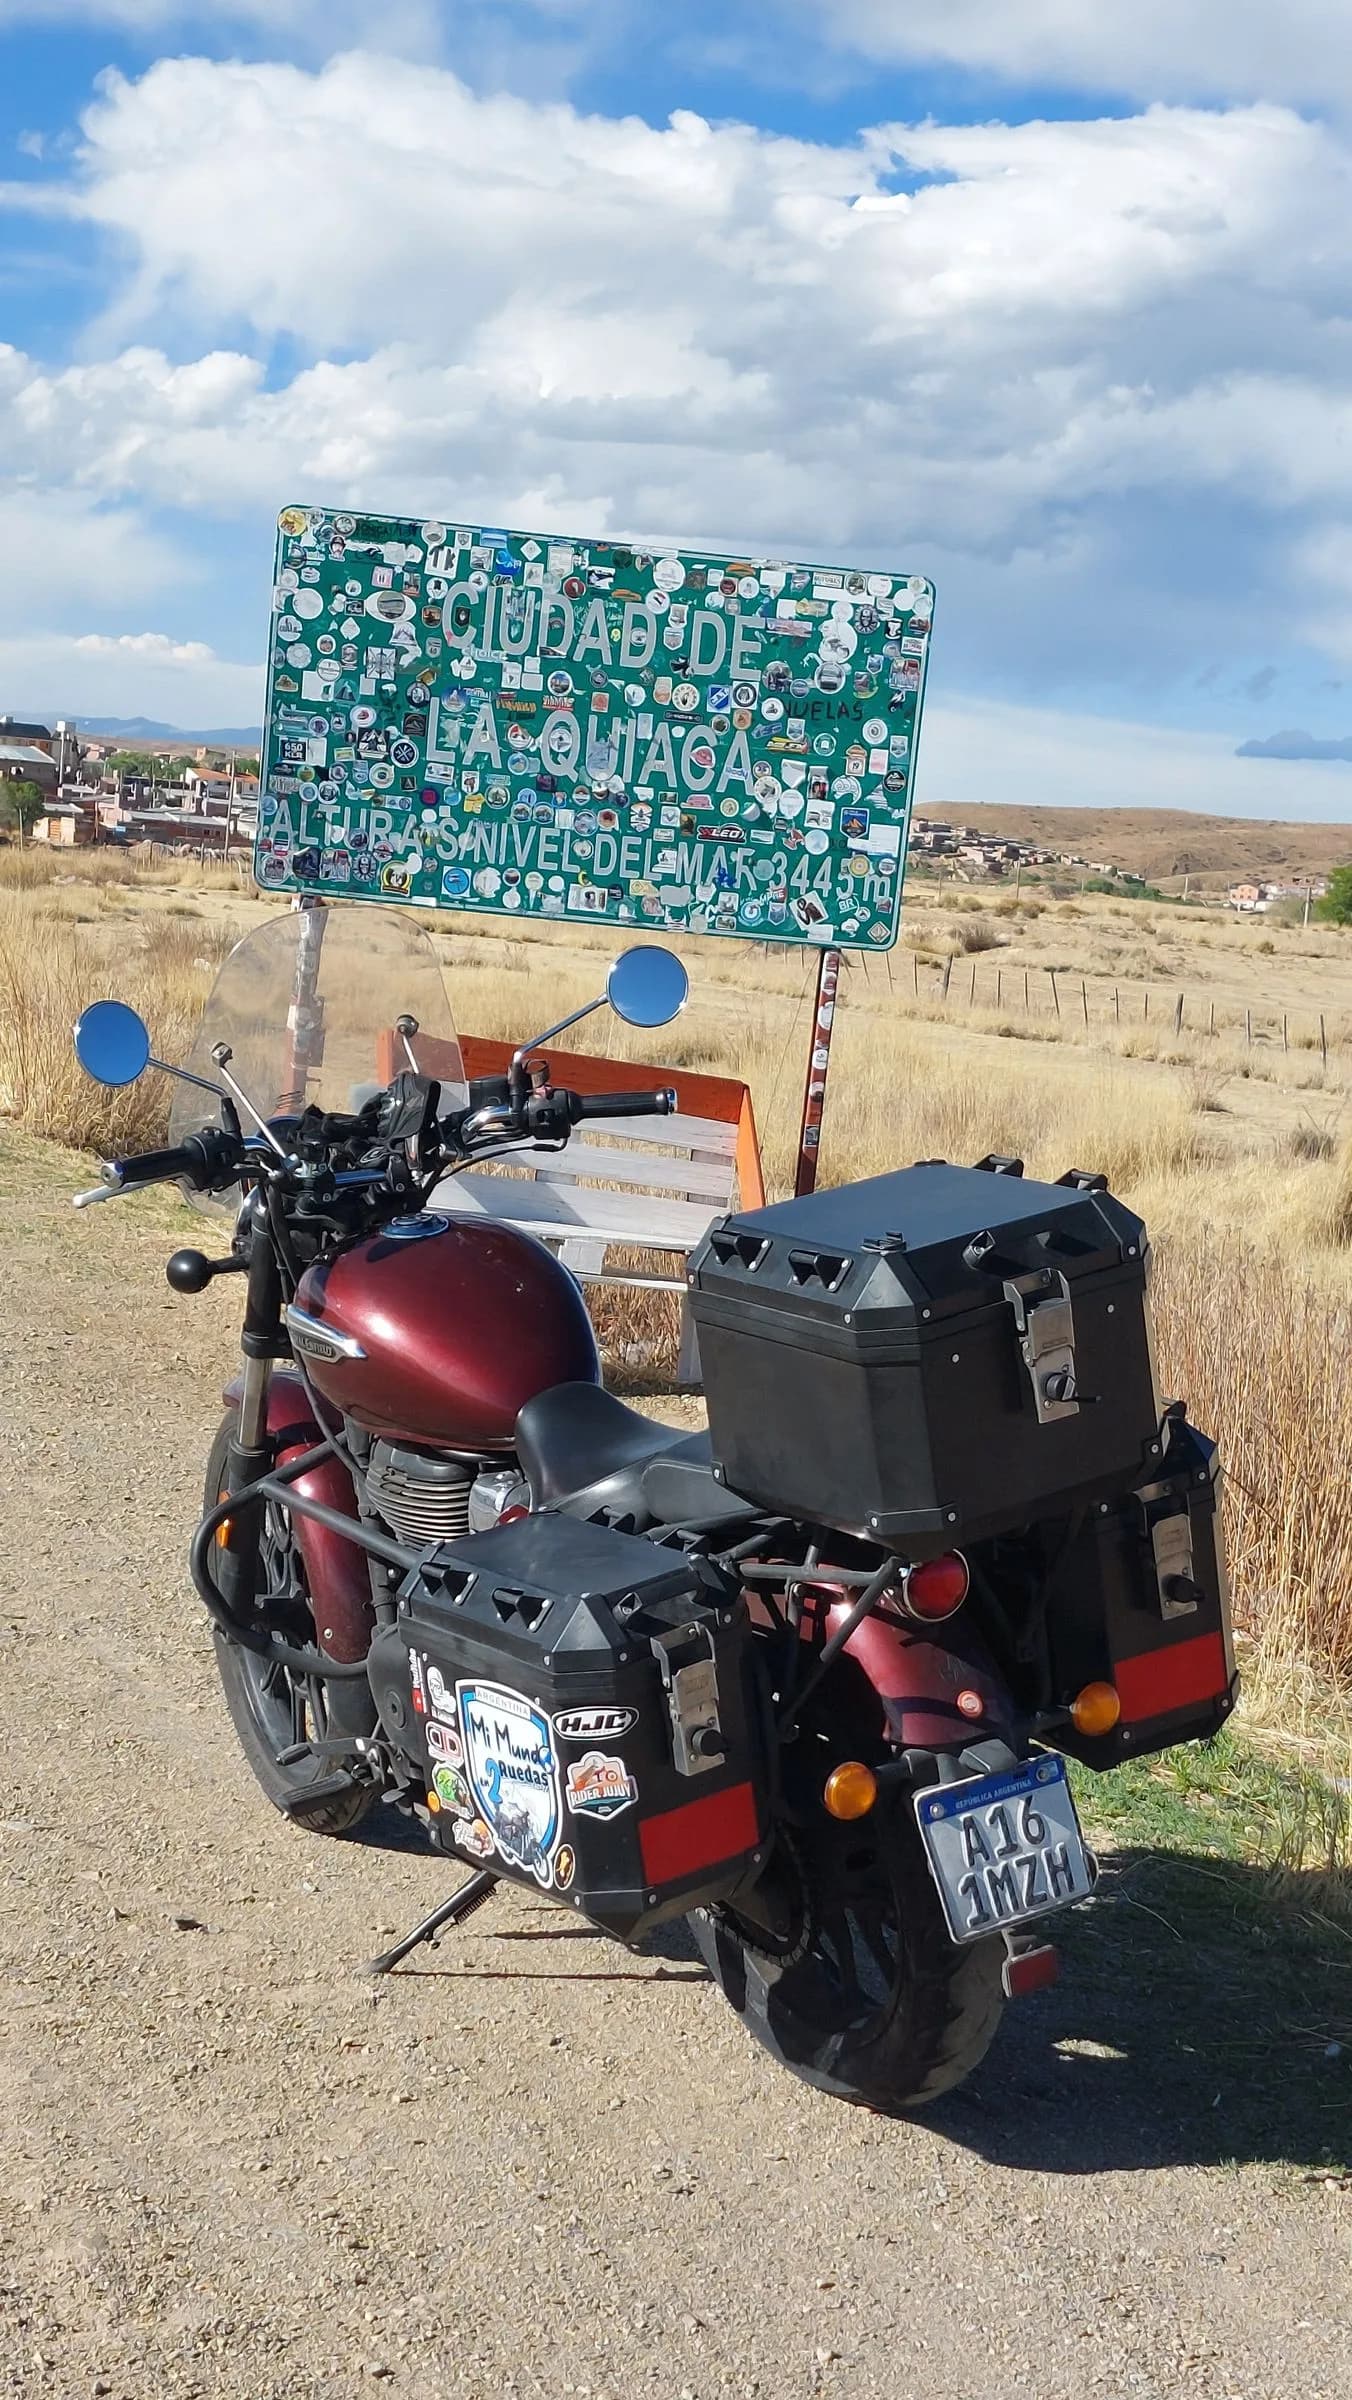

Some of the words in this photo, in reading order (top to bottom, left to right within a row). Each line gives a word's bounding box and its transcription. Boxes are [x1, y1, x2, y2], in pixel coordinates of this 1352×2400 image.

[442, 582, 657, 668] CIUDAD
[690, 610, 766, 681] DE
[426, 697, 502, 769] LA
[540, 709, 757, 796] QUIACA
[269, 799, 424, 858] ALTURA
[593, 833, 662, 881] DEL
[675, 841, 757, 891] MAR
[768, 851, 855, 900] 3445
[862, 874, 892, 902] m
[476, 1690, 528, 1715] ARGENTINA
[561, 1711, 630, 1732] HJC
[470, 1712, 491, 1748] Mi
[485, 1758, 502, 1804] 2
[498, 1760, 548, 1786] Ruedas
[570, 1788, 601, 1806] RIDER
[602, 1783, 632, 1798] JUJUY
[994, 1779, 1032, 1797] ARGENTINA
[960, 1795, 1046, 1869] A16
[958, 1843, 1076, 1929] 1MZH
